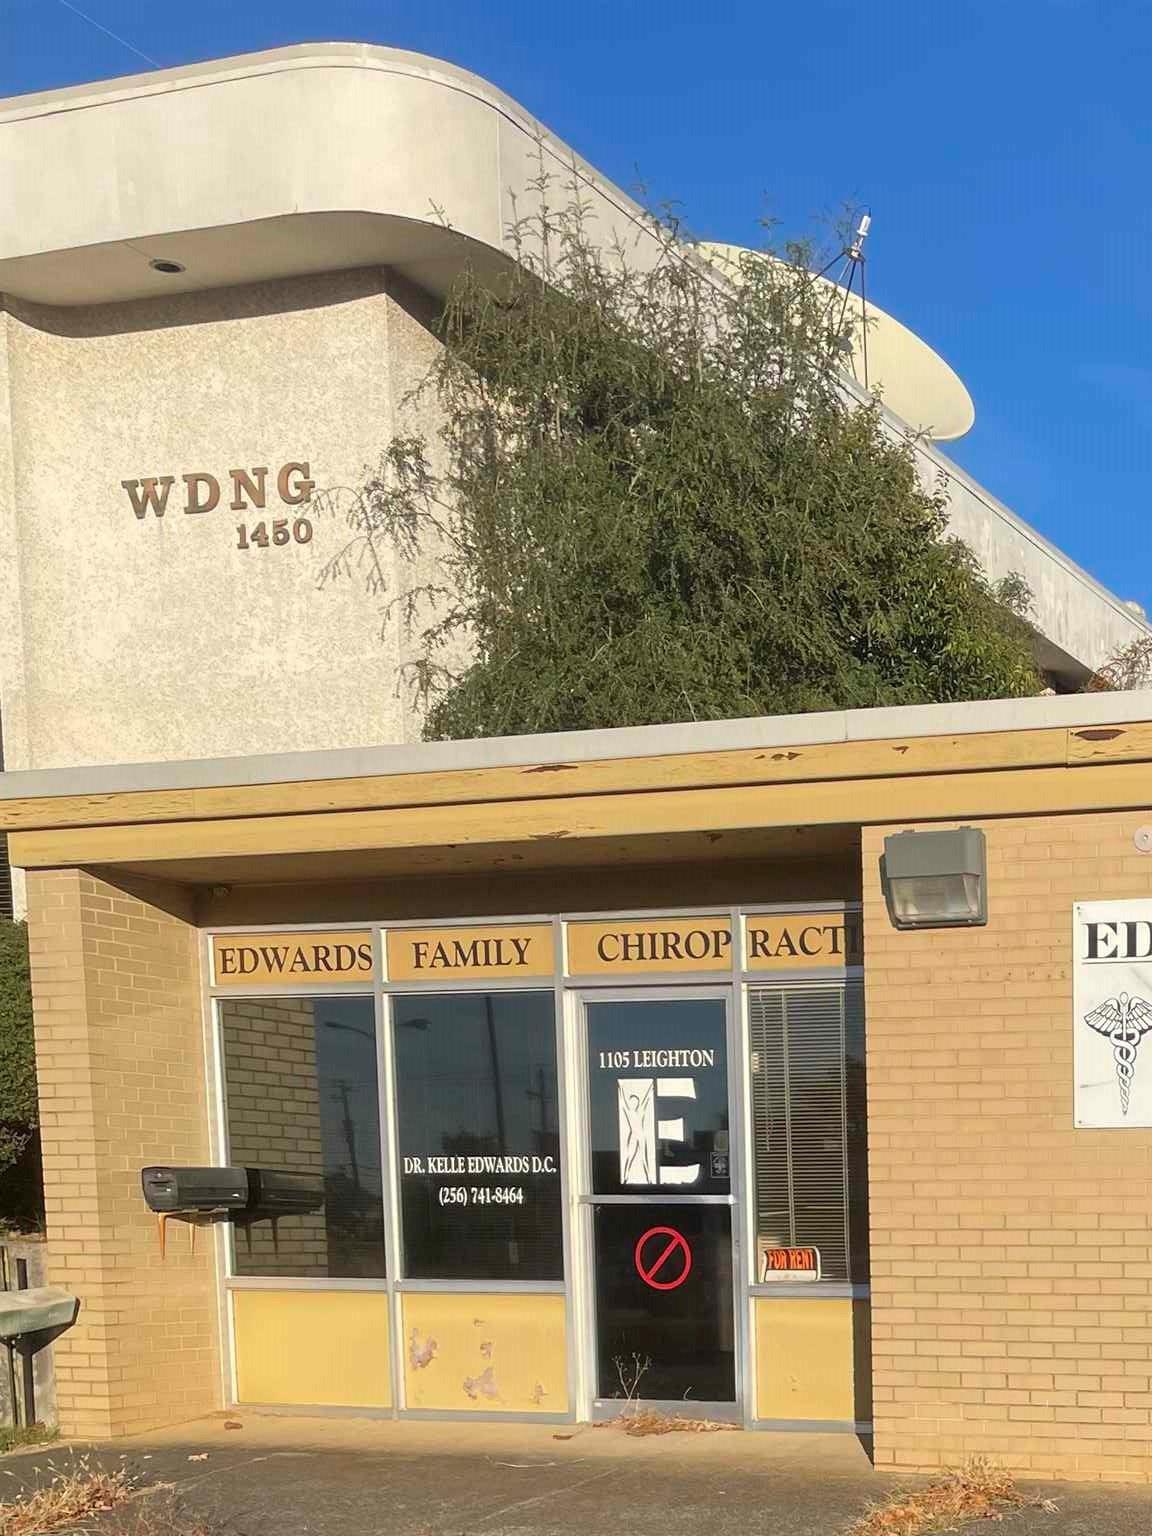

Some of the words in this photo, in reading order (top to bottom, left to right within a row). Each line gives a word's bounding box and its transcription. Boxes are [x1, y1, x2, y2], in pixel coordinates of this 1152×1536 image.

[121, 462, 315, 519] WDNG
[236, 518, 313, 549] 1450
[218, 943, 373, 974] EDWARDS
[412, 938, 531, 968] FAMILY
[599, 1052, 630, 1068] 1105
[633, 1050, 714, 1068] LEIGHTON
[404, 1157, 425, 1174] DR.
[427, 1156, 465, 1174] KELLE
[467, 1156, 530, 1173] EDWARDS
[532, 1156, 557, 1173] D.C.
[439, 1187, 467, 1206] (256)
[471, 1187, 523, 1204] 741-8464
[768, 1250, 787, 1269] FOR
[789, 1248, 814, 1270] RENT
